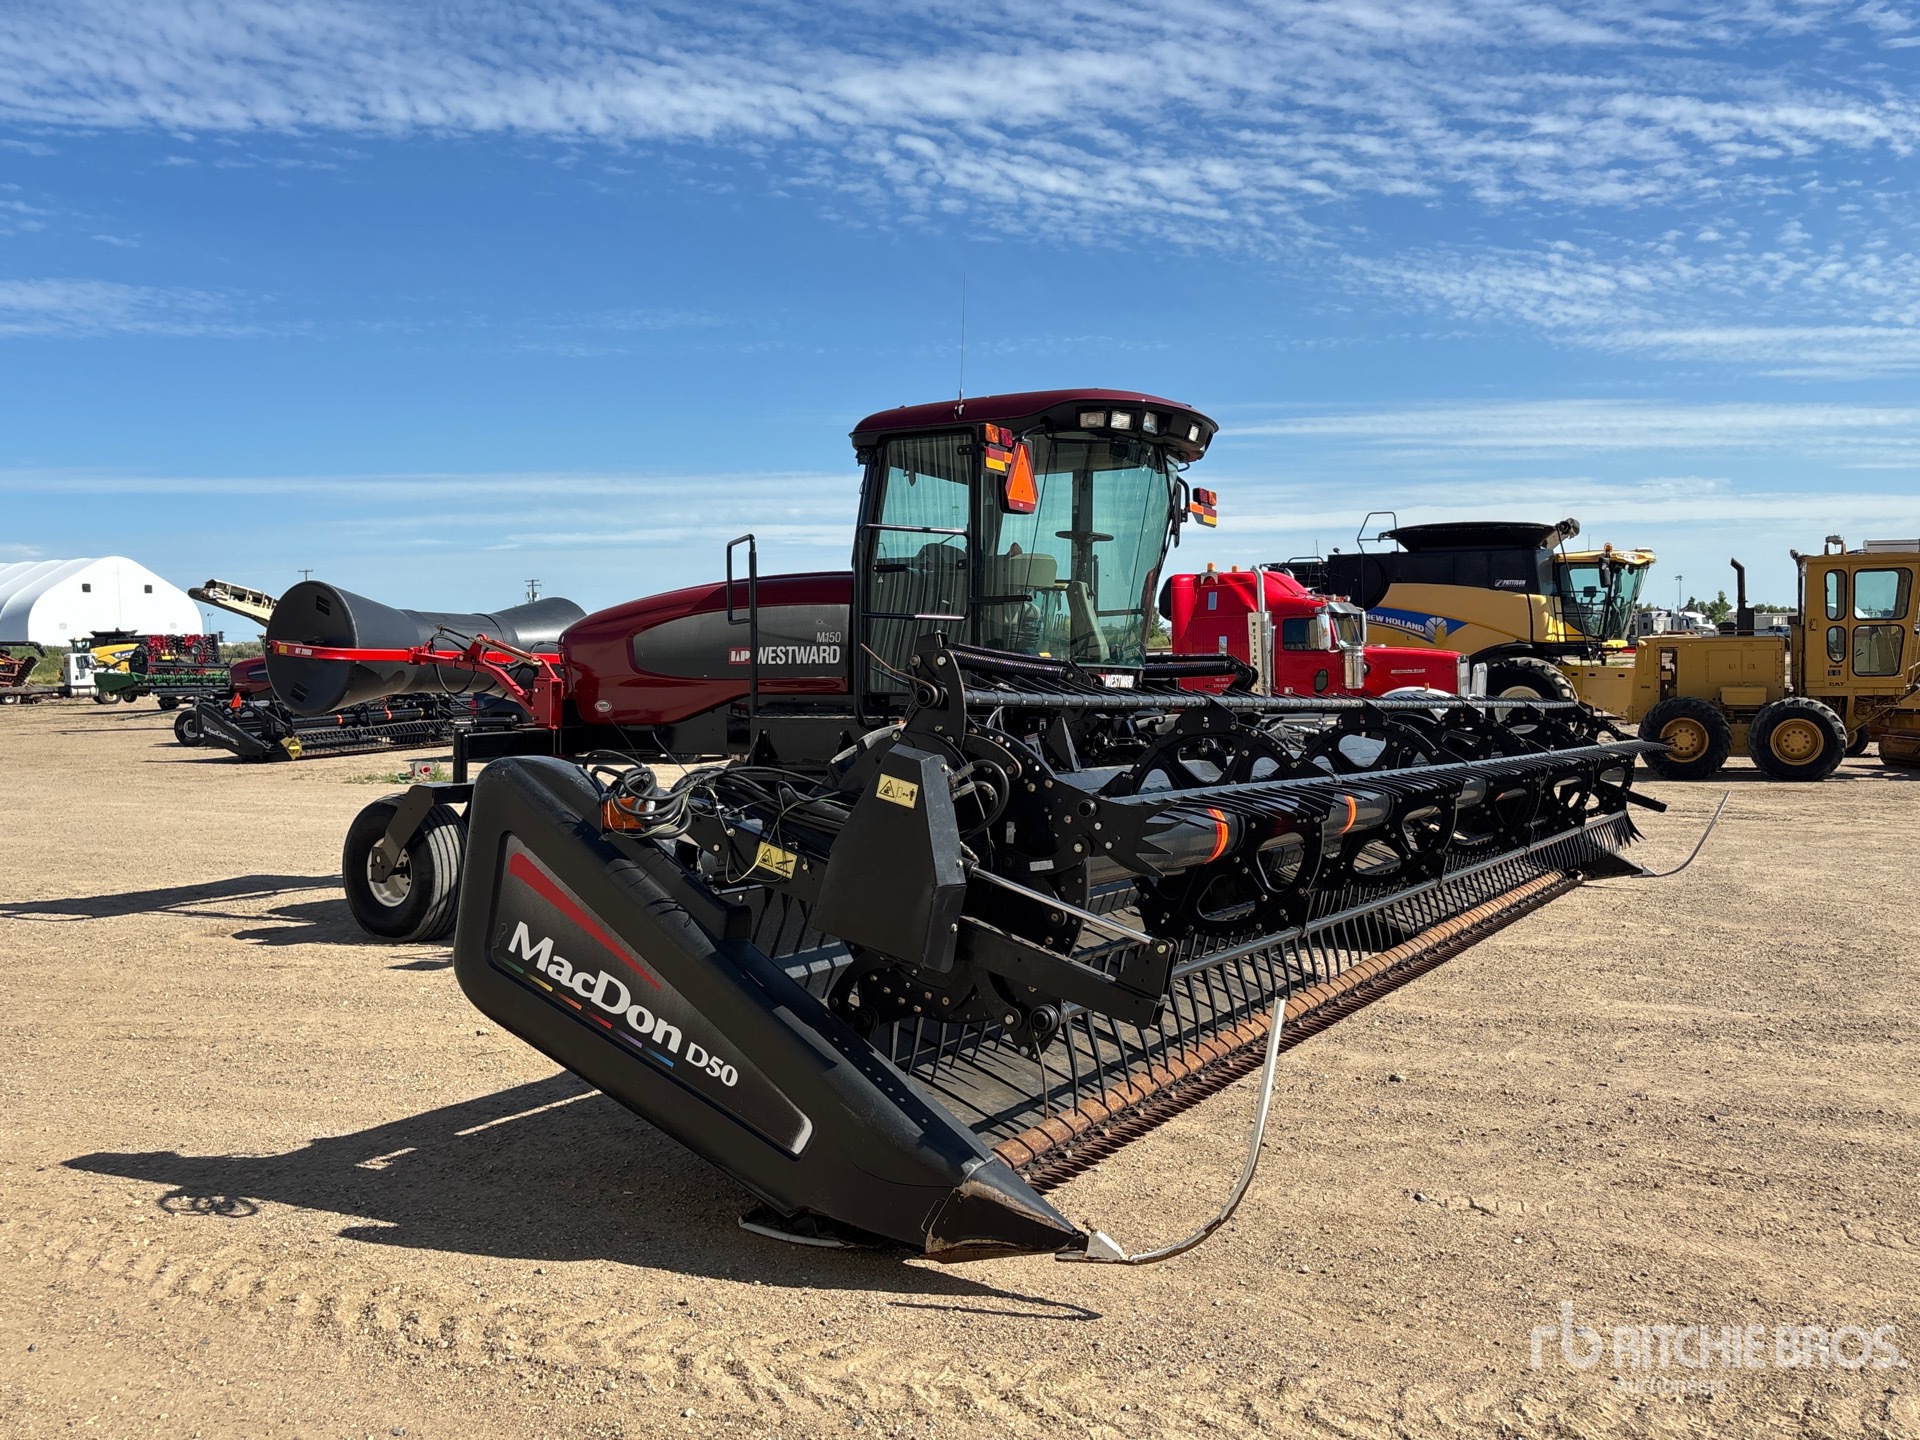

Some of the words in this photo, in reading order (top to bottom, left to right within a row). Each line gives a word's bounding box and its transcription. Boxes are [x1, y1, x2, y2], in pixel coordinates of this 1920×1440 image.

[1365, 613, 1383, 622] NEW
[1385, 617, 1424, 632] HOLLAND
[816, 632, 841, 643] M150
[757, 645, 840, 664] WESTWARD
[203, 725, 229, 740] MacDon
[508, 920, 683, 1054] MacDon
[685, 1041, 739, 1088] D50
